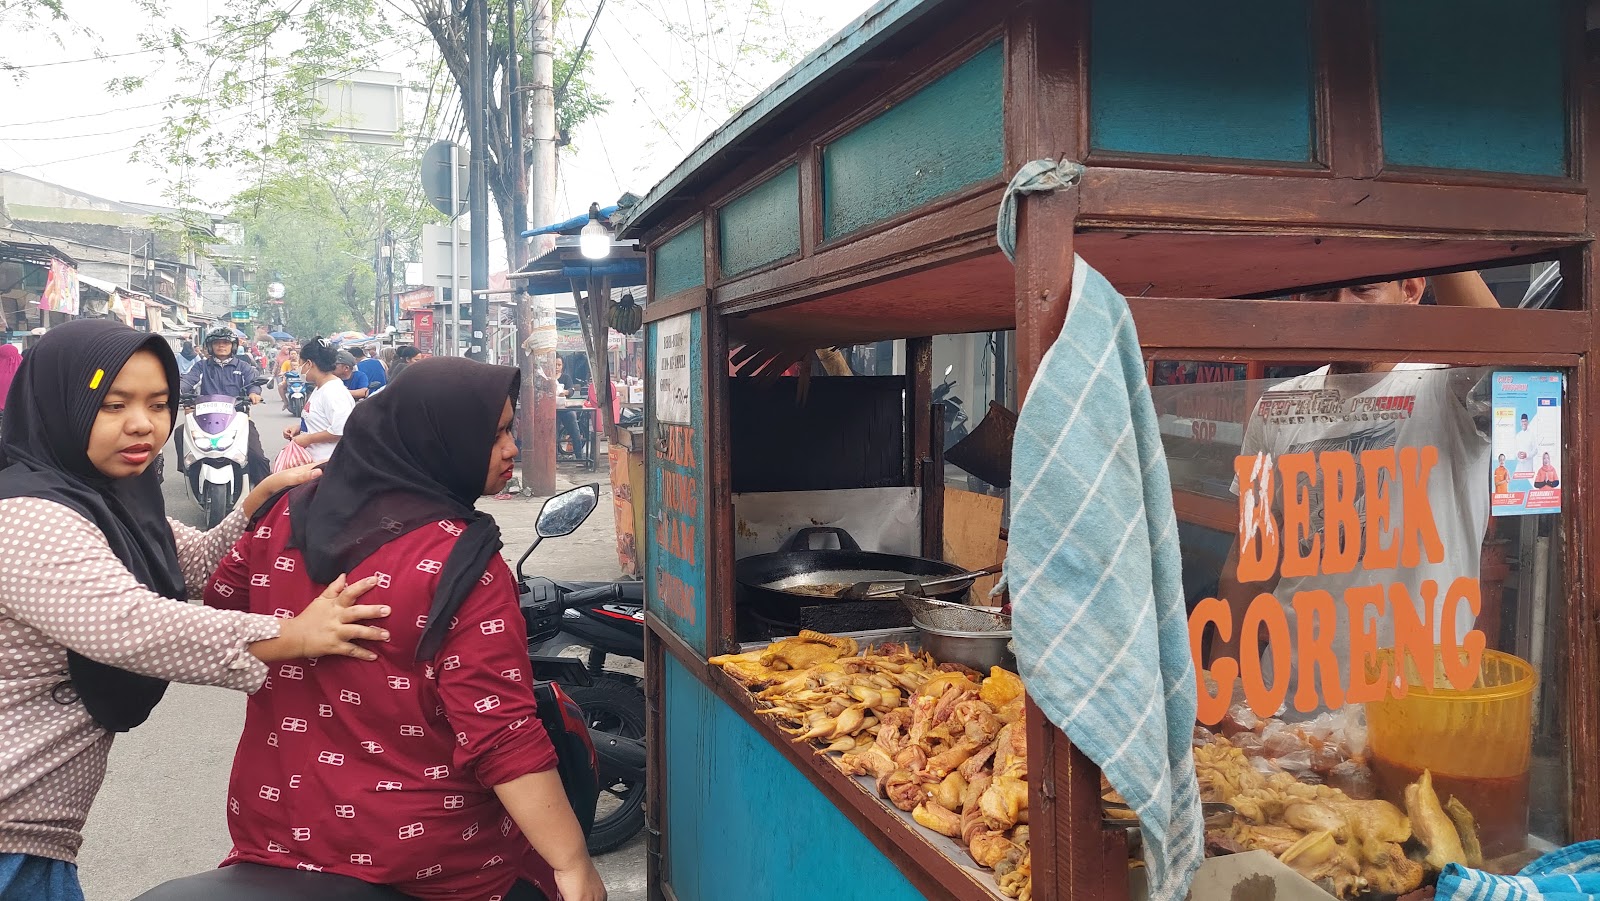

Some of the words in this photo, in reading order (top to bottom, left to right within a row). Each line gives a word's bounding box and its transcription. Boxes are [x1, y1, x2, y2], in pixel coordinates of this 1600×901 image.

[1192, 420, 1217, 444] SOP
[1234, 445, 1445, 583] BEBEK
[1188, 577, 1486, 726] GORENG
